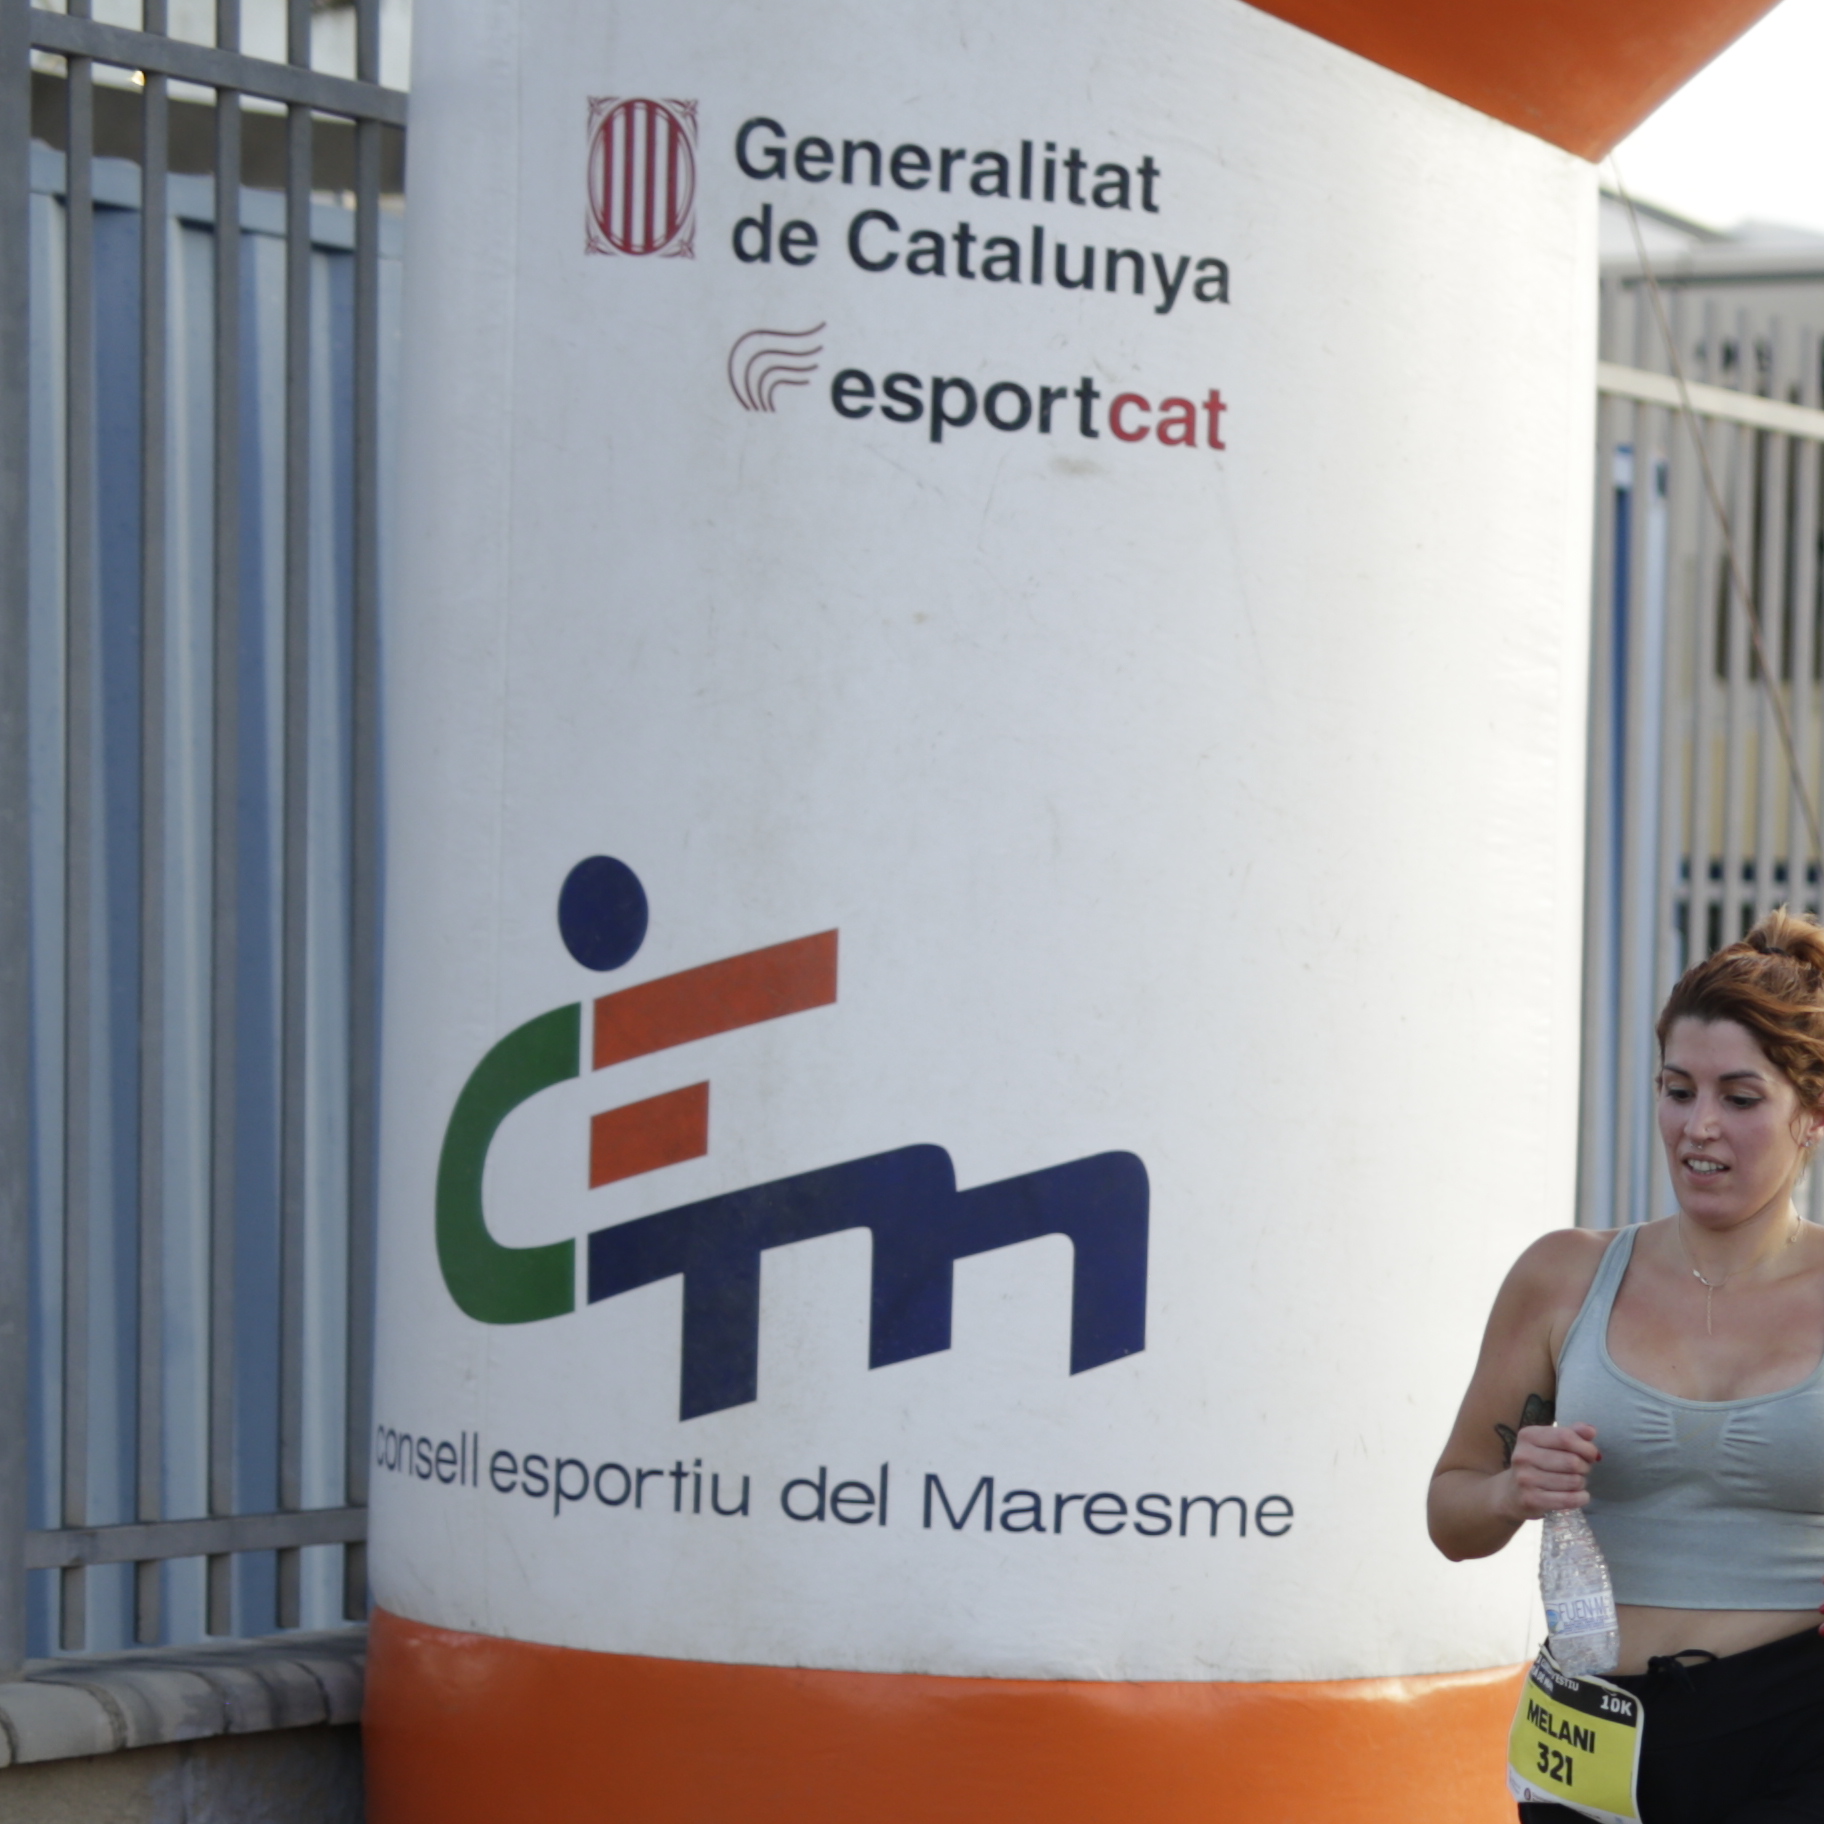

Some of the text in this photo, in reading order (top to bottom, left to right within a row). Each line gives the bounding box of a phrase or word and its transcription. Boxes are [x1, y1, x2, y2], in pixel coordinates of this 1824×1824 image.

[733, 115, 1162, 215] Generalitat
[730, 201, 1231, 316] de Catalunya
[829, 367, 1228, 452] esportcat
[375, 1424, 1295, 1539] consell esportiu del Maresme
[1526, 1698, 1596, 1754] MELANI
[1600, 1694, 1633, 1717] 10K
[1537, 1740, 1573, 1787] 321
